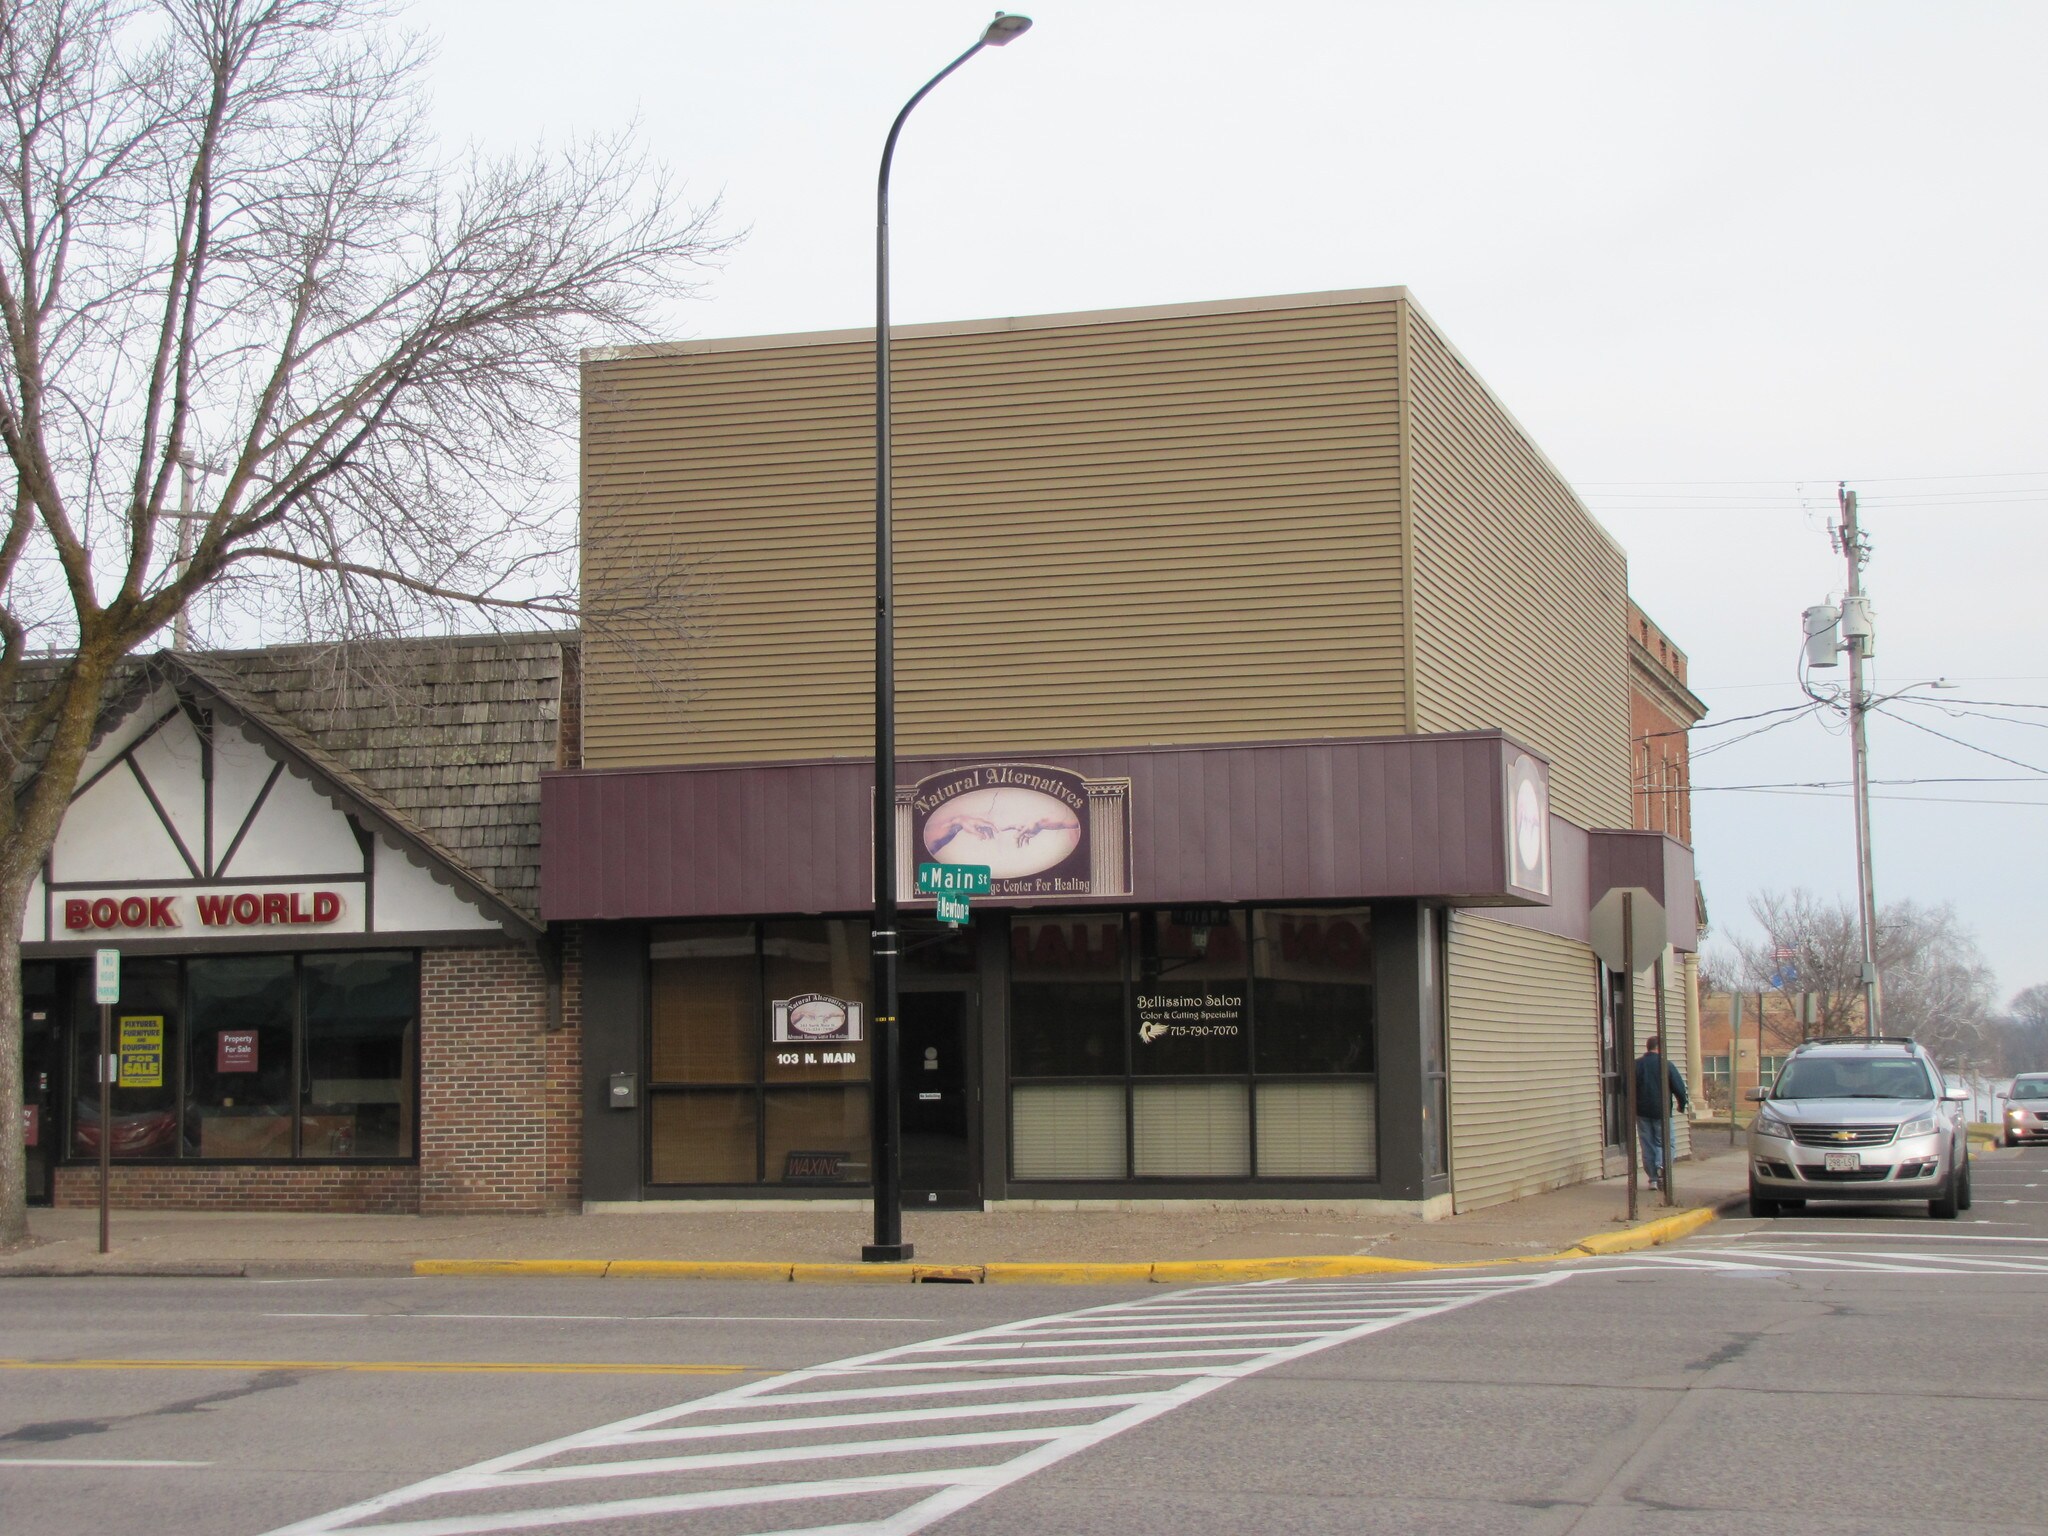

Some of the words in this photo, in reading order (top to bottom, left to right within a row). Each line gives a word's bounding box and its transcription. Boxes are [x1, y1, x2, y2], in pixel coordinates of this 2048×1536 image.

[915, 770, 980, 816] Natural
[986, 766, 1084, 810] Alternatives
[921, 871, 928, 883] N
[931, 867, 973, 890] Main
[978, 873, 988, 885] St
[1003, 879, 1032, 893] Center
[1036, 879, 1051, 891] For
[1054, 878, 1090, 892] Healing
[64, 896, 181, 930] BOOK
[197, 891, 342, 926] WORLD
[941, 896, 965, 919] Newton
[1137, 995, 1202, 1009] Bellissimo
[1205, 994, 1241, 1007] Salon
[1140, 1011, 1162, 1020] Color
[1163, 1011, 1170, 1019] &
[1171, 1011, 1199, 1020] Cutting
[1200, 1010, 1238, 1020] Specialist
[123, 1029, 160, 1037] FURNITURE
[1170, 1025, 1238, 1036] 715-790-7070
[224, 1035, 253, 1044] Property
[122, 1043, 160, 1051] EQUIPMENT
[237, 1045, 251, 1053] Sale
[777, 1053, 799, 1064] 103
[804, 1053, 817, 1064] N.
[822, 1052, 856, 1063] MAIN
[123, 1062, 158, 1075] SALE
[788, 1157, 843, 1176] WAXING
